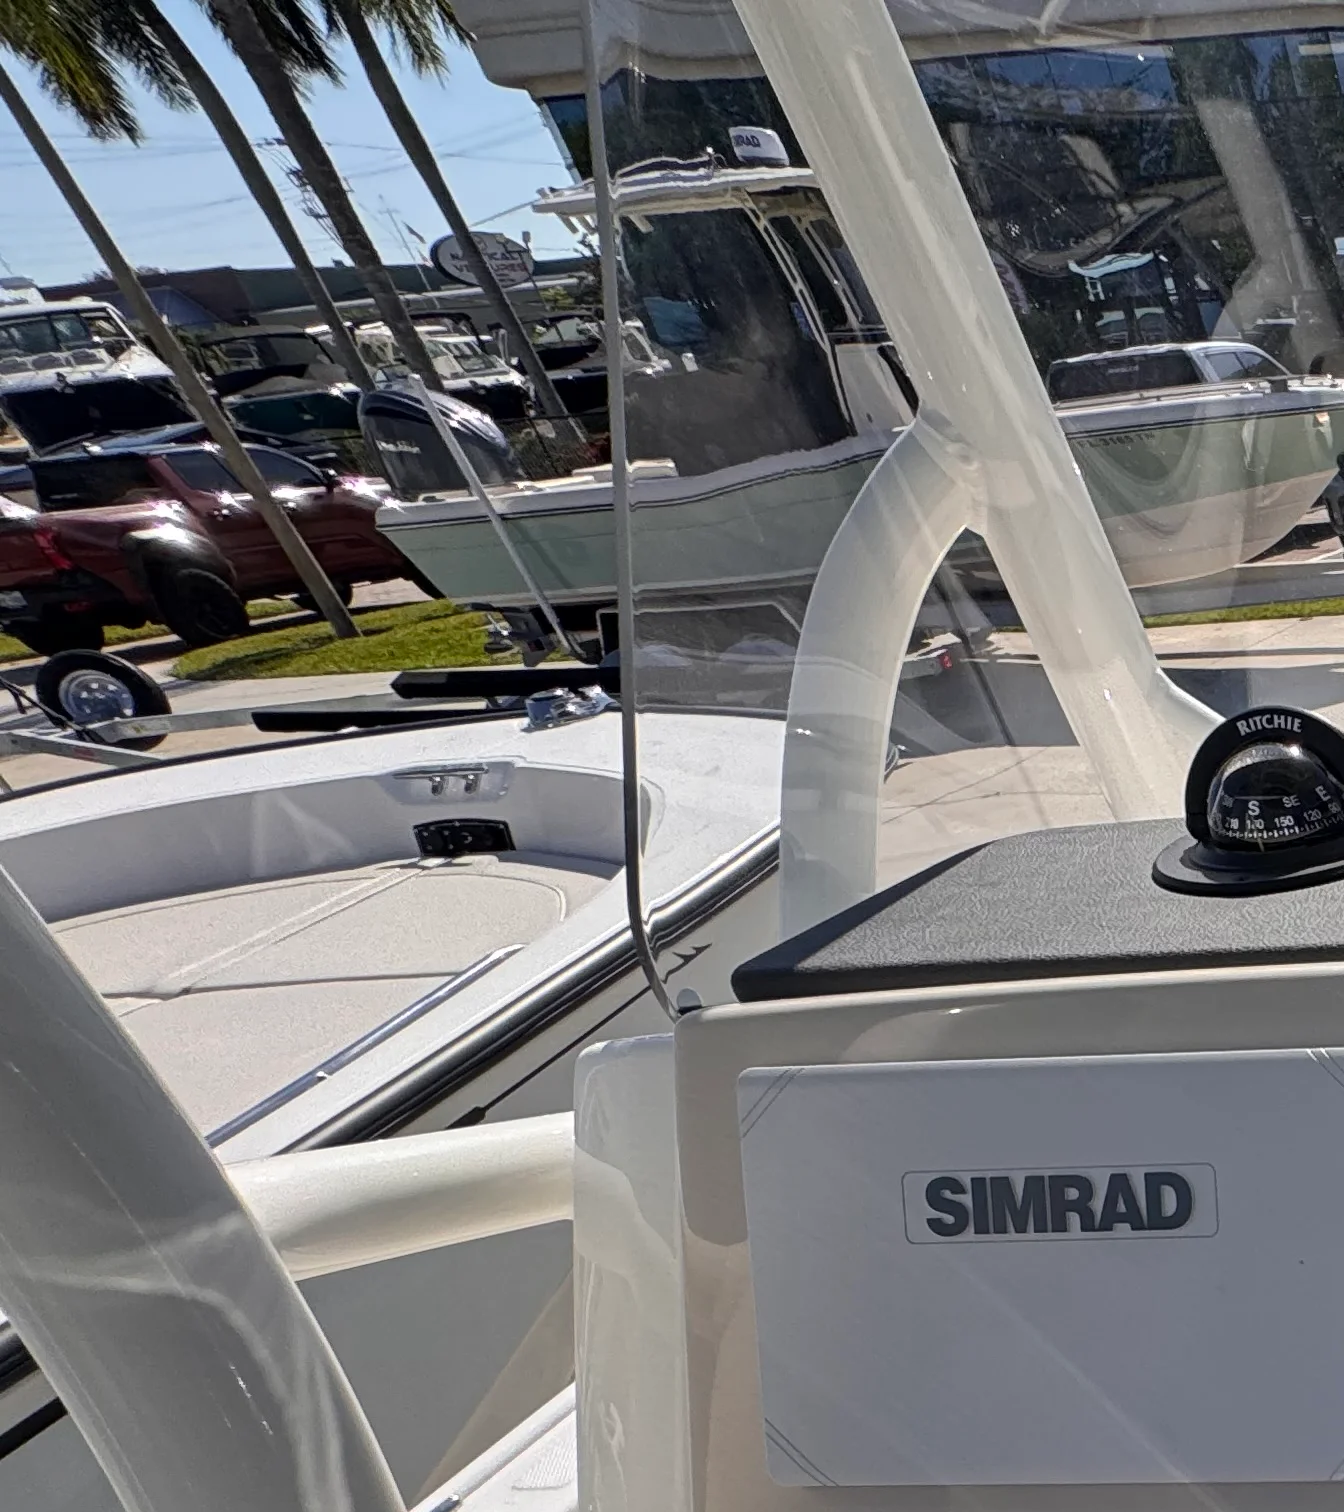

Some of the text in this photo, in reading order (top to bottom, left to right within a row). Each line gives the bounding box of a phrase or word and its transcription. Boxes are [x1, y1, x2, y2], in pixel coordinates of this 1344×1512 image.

[1236, 714, 1303, 736] RITCHIE
[1315, 785, 1331, 802] E
[1247, 801, 1261, 816] S
[1282, 795, 1300, 809] SE
[1274, 815, 1295, 828] 150
[925, 1171, 1194, 1238] SIMRAD
